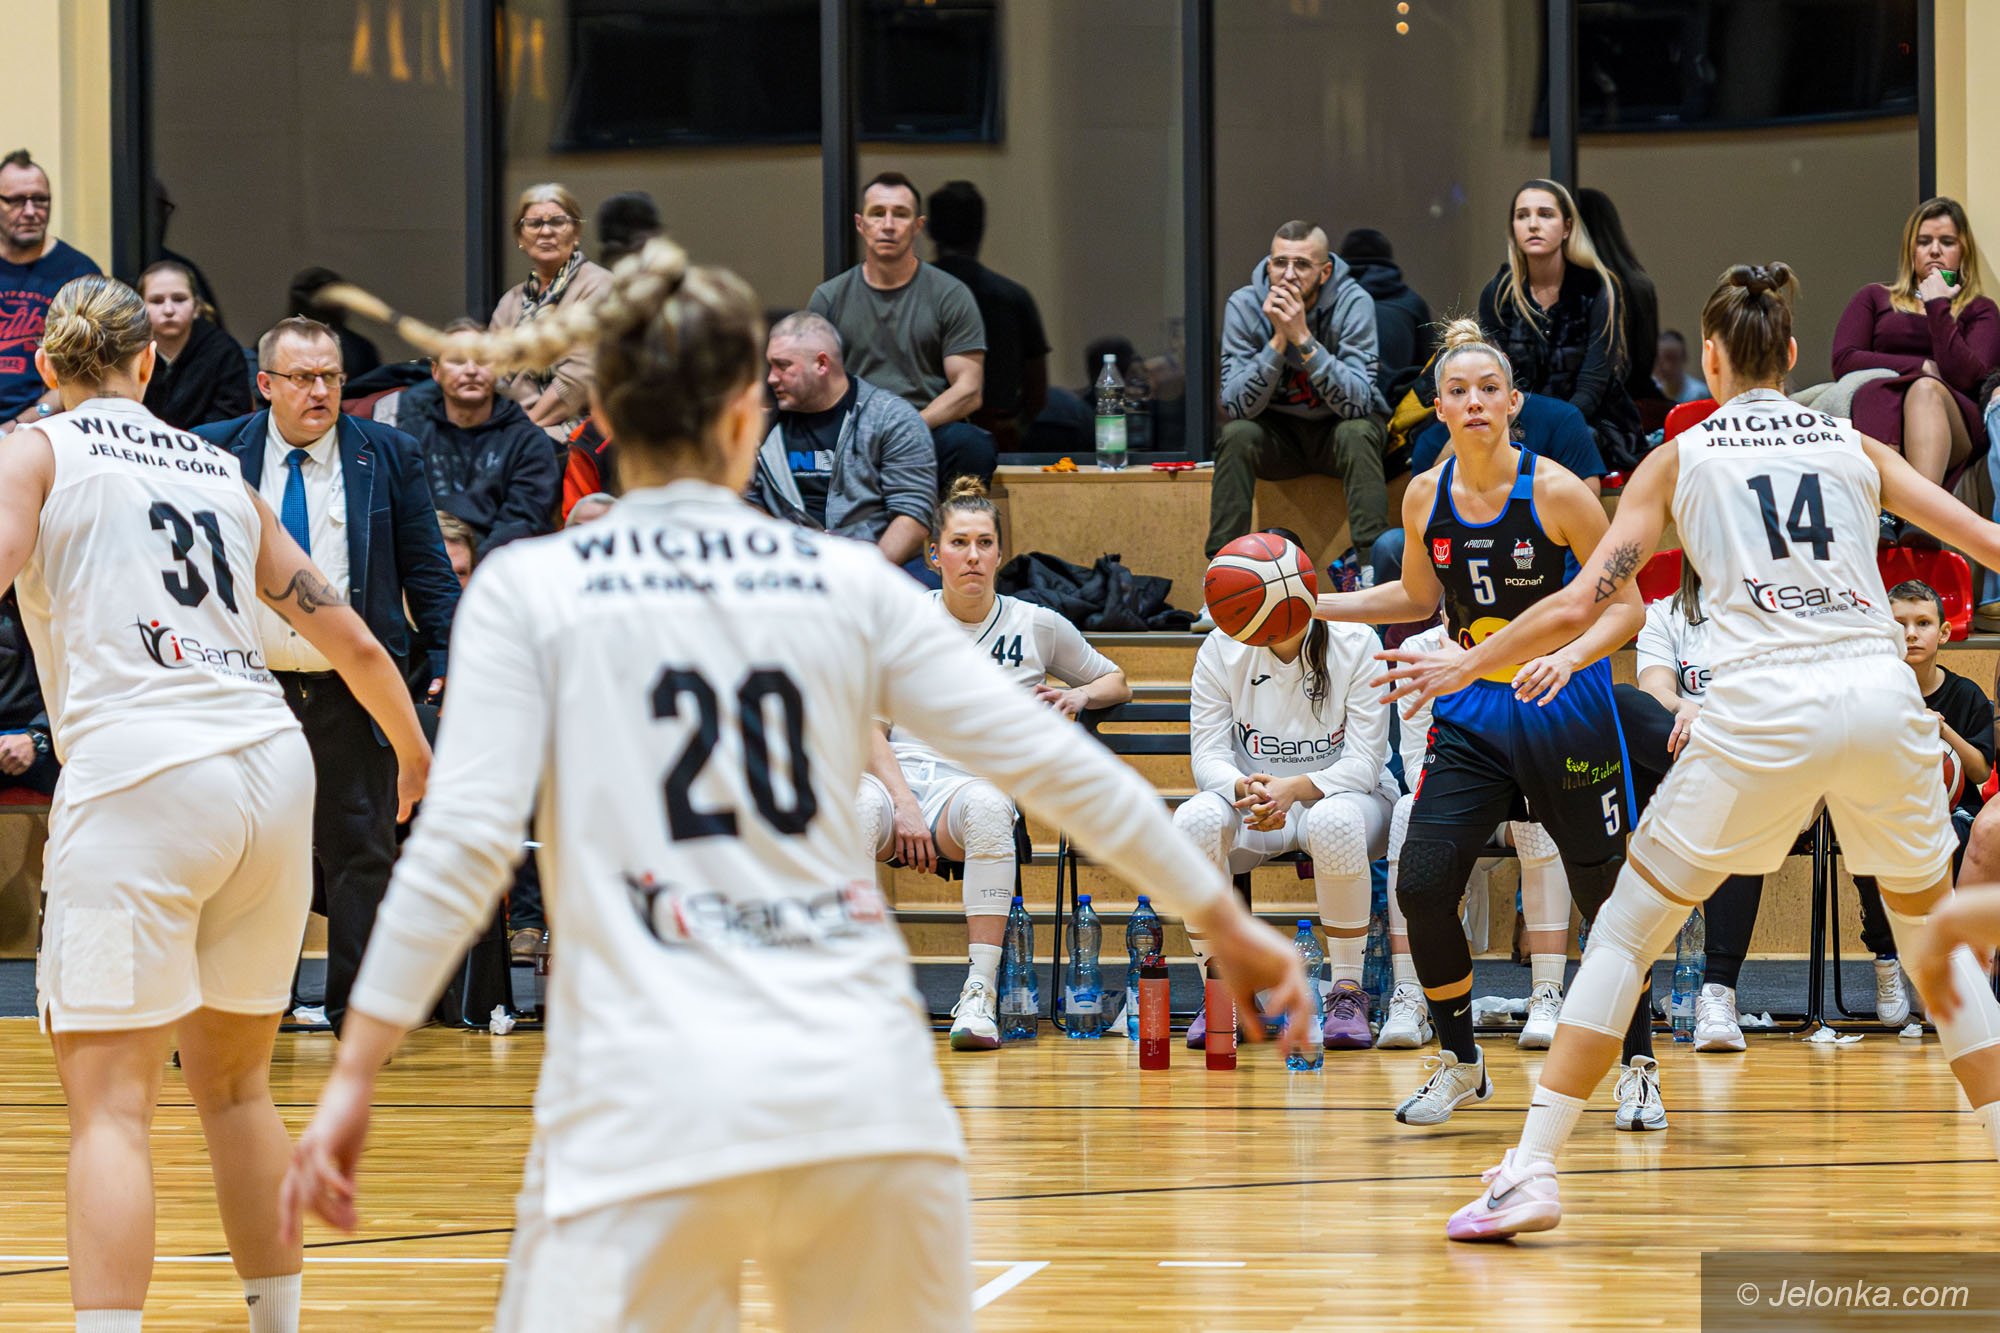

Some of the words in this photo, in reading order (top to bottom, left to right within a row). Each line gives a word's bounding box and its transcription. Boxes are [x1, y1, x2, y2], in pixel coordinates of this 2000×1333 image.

[69, 416, 220, 457] WICHOS
[1701, 413, 1838, 432] WICHOS
[1706, 436, 1786, 447] JELENIA
[1793, 431, 1846, 446] GÓRA
[89, 443, 170, 469] JELENIA
[175, 457, 231, 479] GÓRA
[1746, 473, 1835, 561] 14
[148, 501, 239, 615] 31
[572, 528, 819, 561] WICHOS
[1468, 539, 1495, 549] PROTON
[1467, 558, 1496, 605] 5
[991, 634, 1024, 667] 44
[651, 666, 818, 842] 20
[1270, 755, 1314, 764] enklawa
[1601, 787, 1620, 836] 5
